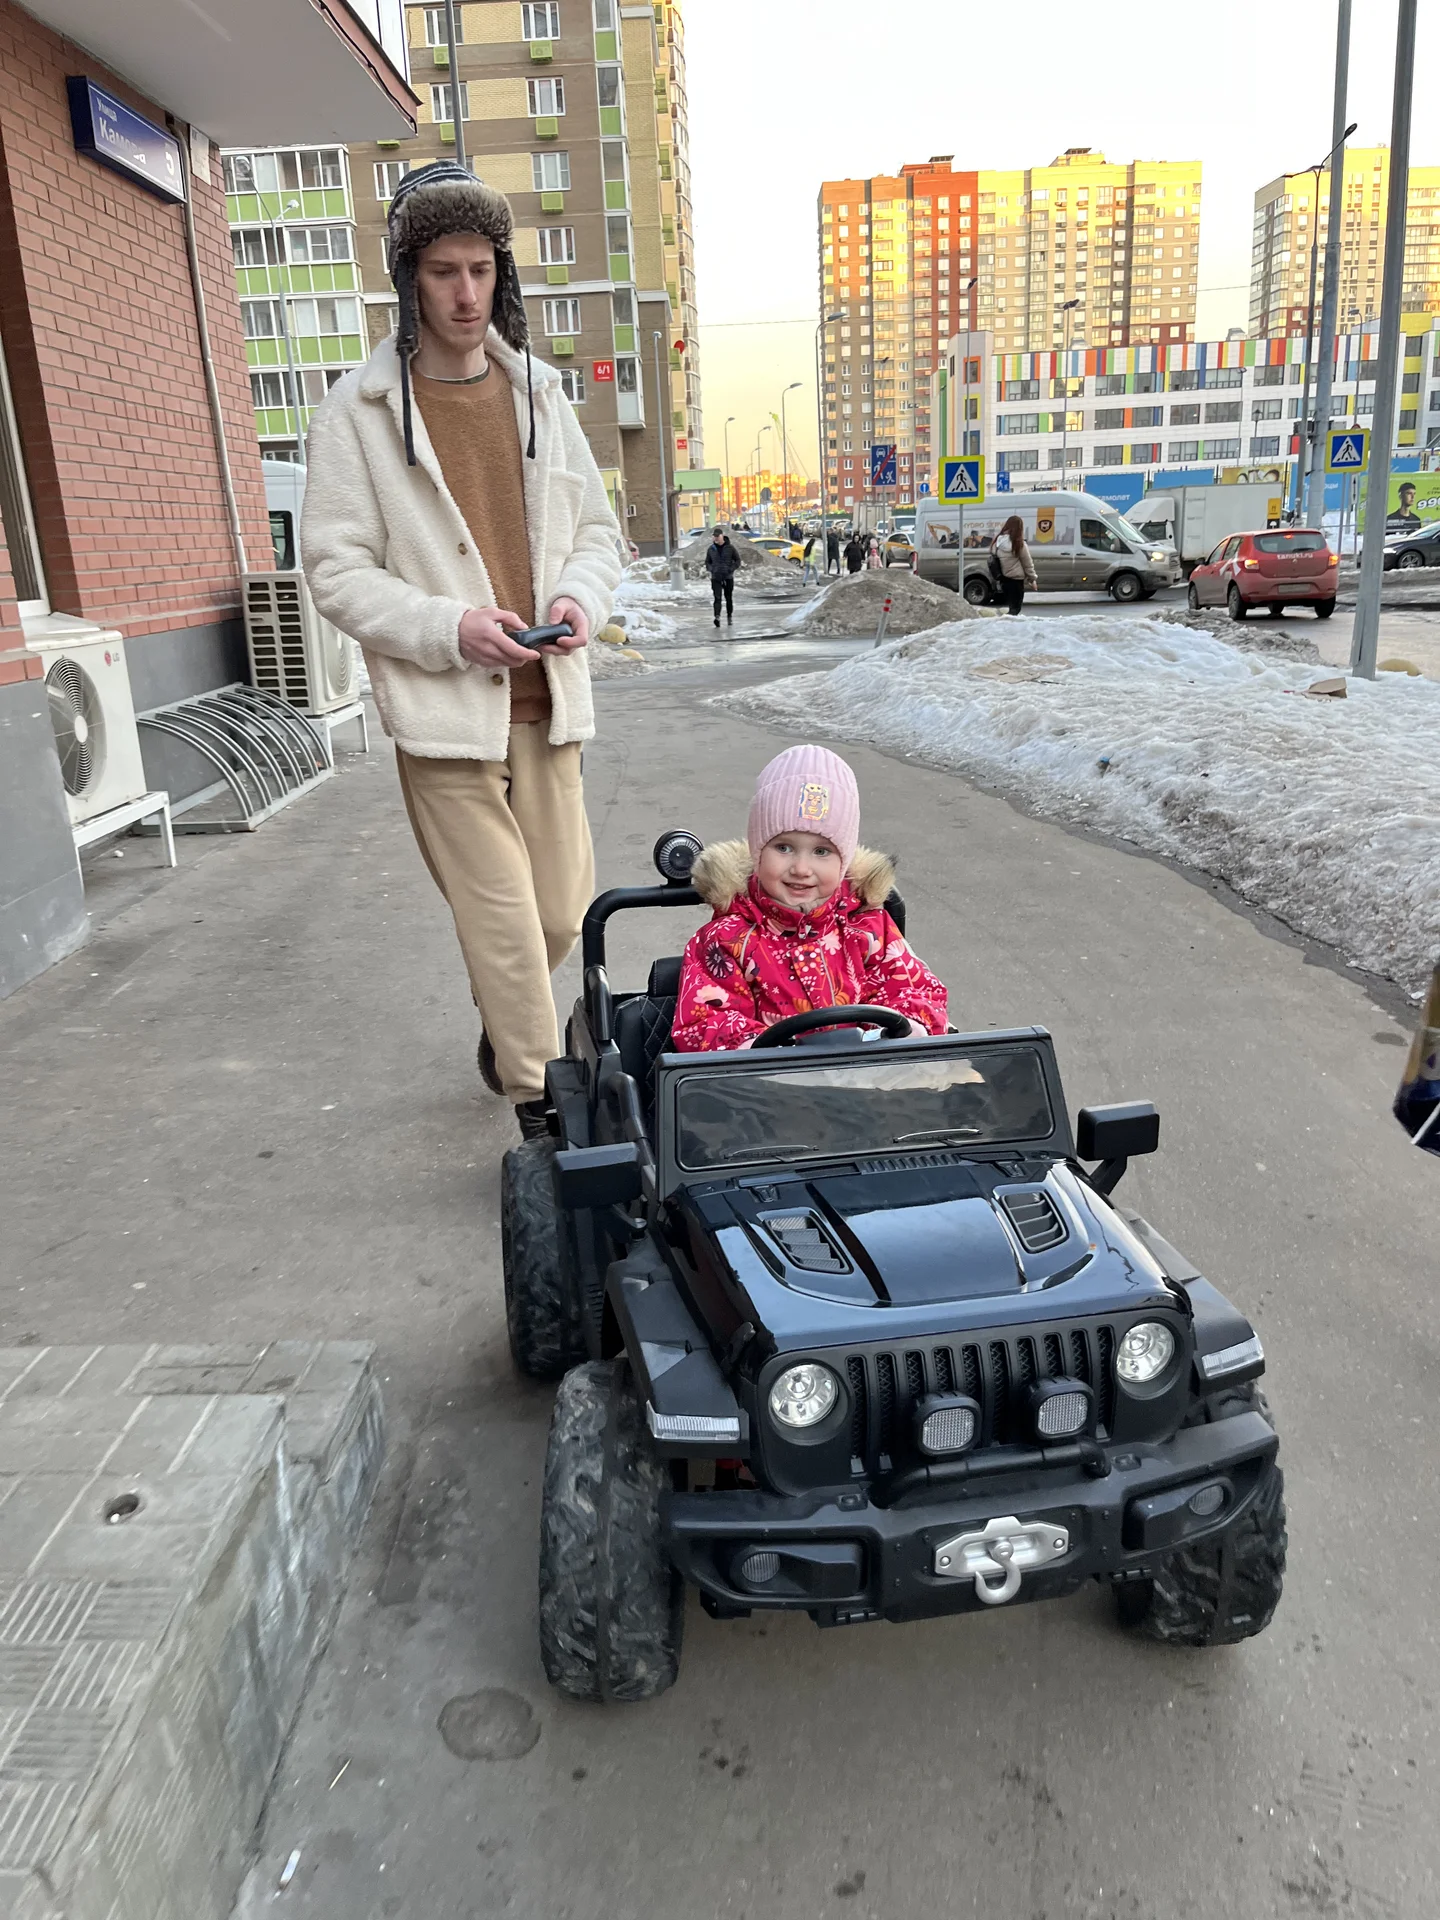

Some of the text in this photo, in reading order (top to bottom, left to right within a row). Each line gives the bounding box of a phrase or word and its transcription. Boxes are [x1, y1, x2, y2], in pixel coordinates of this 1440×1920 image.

[597, 364, 610, 375] 6/1
[1277, 552, 1314, 560] tanuki.ru
[112, 652, 120, 662] LG
